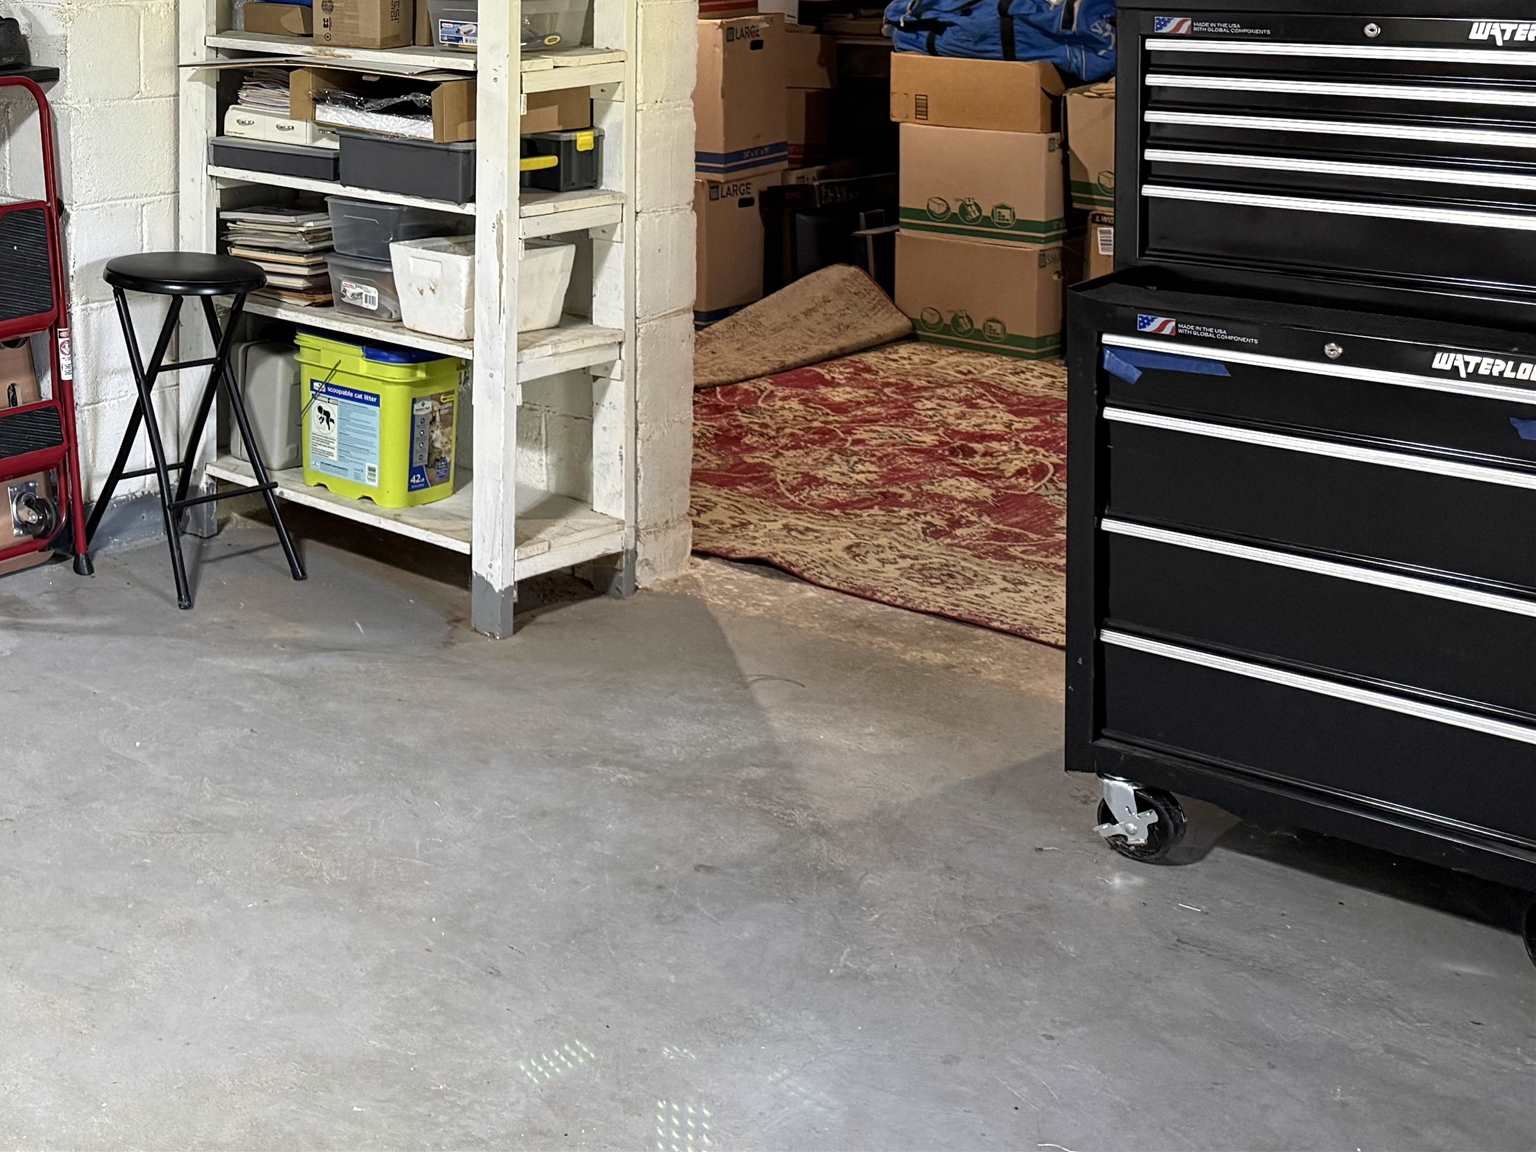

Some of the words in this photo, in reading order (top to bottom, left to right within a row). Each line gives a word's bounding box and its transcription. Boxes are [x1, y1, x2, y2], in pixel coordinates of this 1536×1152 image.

[720, 182, 752, 199] LARGE
[1193, 330, 1217, 339] GLOBAL
[1217, 333, 1259, 345] COMPONENTS
[327, 386, 354, 398] scoopable
[363, 394, 377, 403] litter
[410, 473, 421, 484] 42
